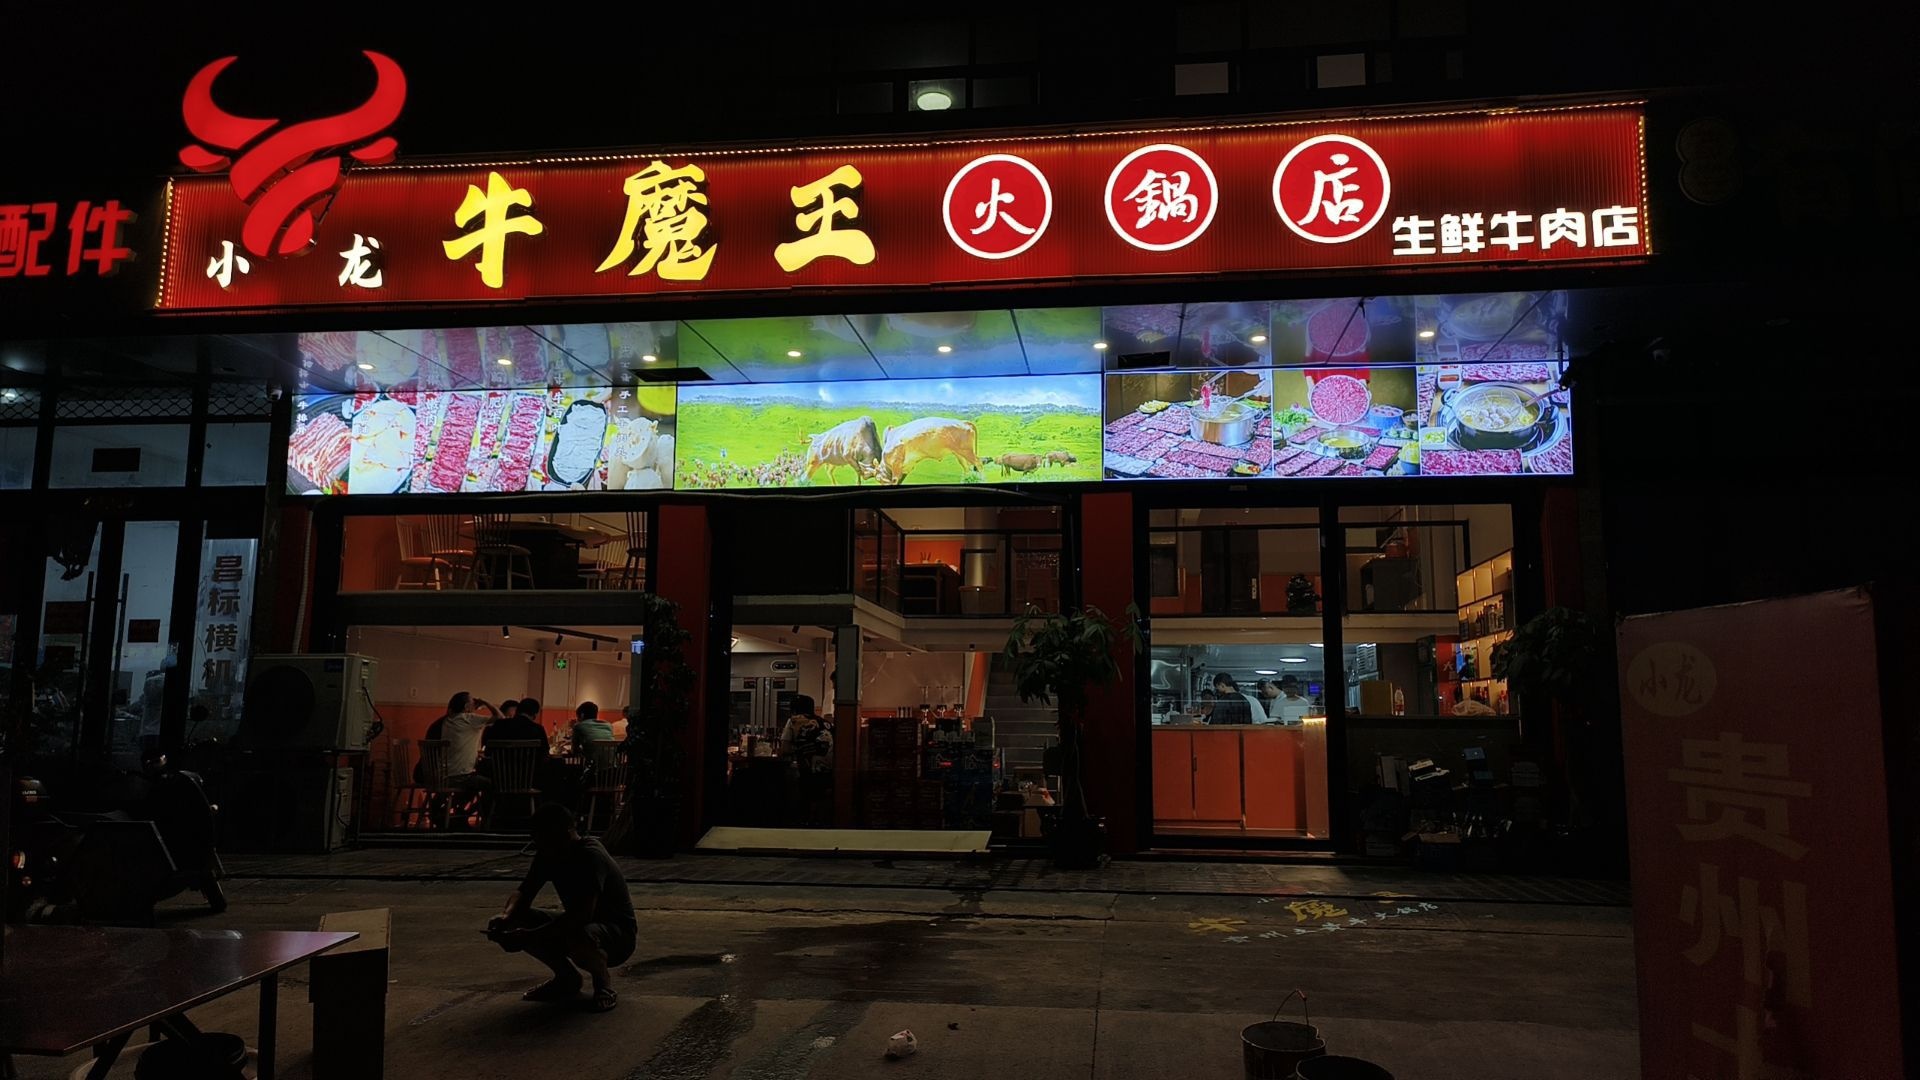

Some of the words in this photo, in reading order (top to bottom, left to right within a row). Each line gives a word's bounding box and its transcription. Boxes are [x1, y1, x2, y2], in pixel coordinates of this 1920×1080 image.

[0, 200, 132, 277] 配件
[442, 160, 876, 288] 牛魔王
[1392, 205, 1639, 256] 生鲜牛肉店
[206, 233, 384, 289] 小龙
